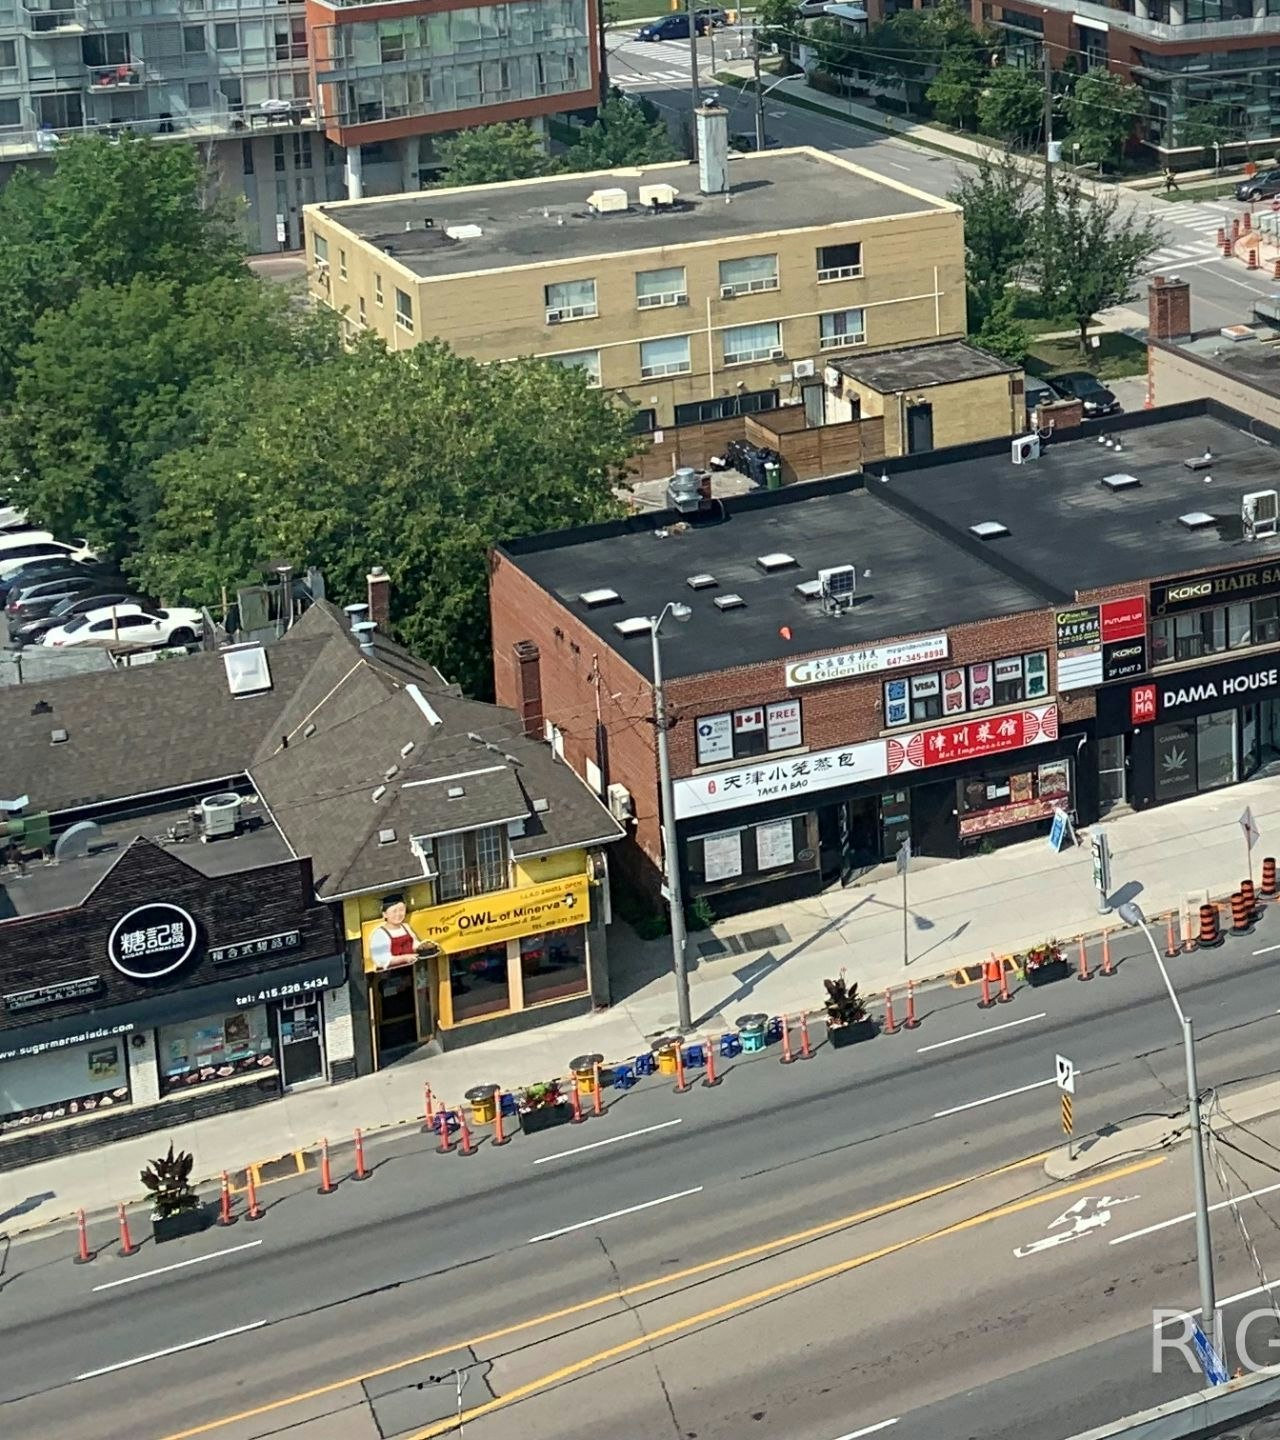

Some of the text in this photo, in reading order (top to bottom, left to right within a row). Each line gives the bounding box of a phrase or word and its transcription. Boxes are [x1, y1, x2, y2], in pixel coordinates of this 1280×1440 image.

[1168, 582, 1212, 601] KOKO
[1214, 573, 1260, 594] HAIR
[1104, 612, 1142, 625] FUTURE UP
[1112, 646, 1142, 658] KOKO
[858, 661, 879, 672] life
[1119, 664, 1135, 675] UNIT
[914, 681, 936, 692] VISA
[1163, 670, 1278, 709] DAMA HOUSE
[1135, 690, 1153, 703] DA
[769, 708, 797, 720] FREE
[1135, 701, 1153, 715] MA
[757, 779, 809, 798] TAKE A BAO
[427, 901, 560, 936] The OWL of Minerva
